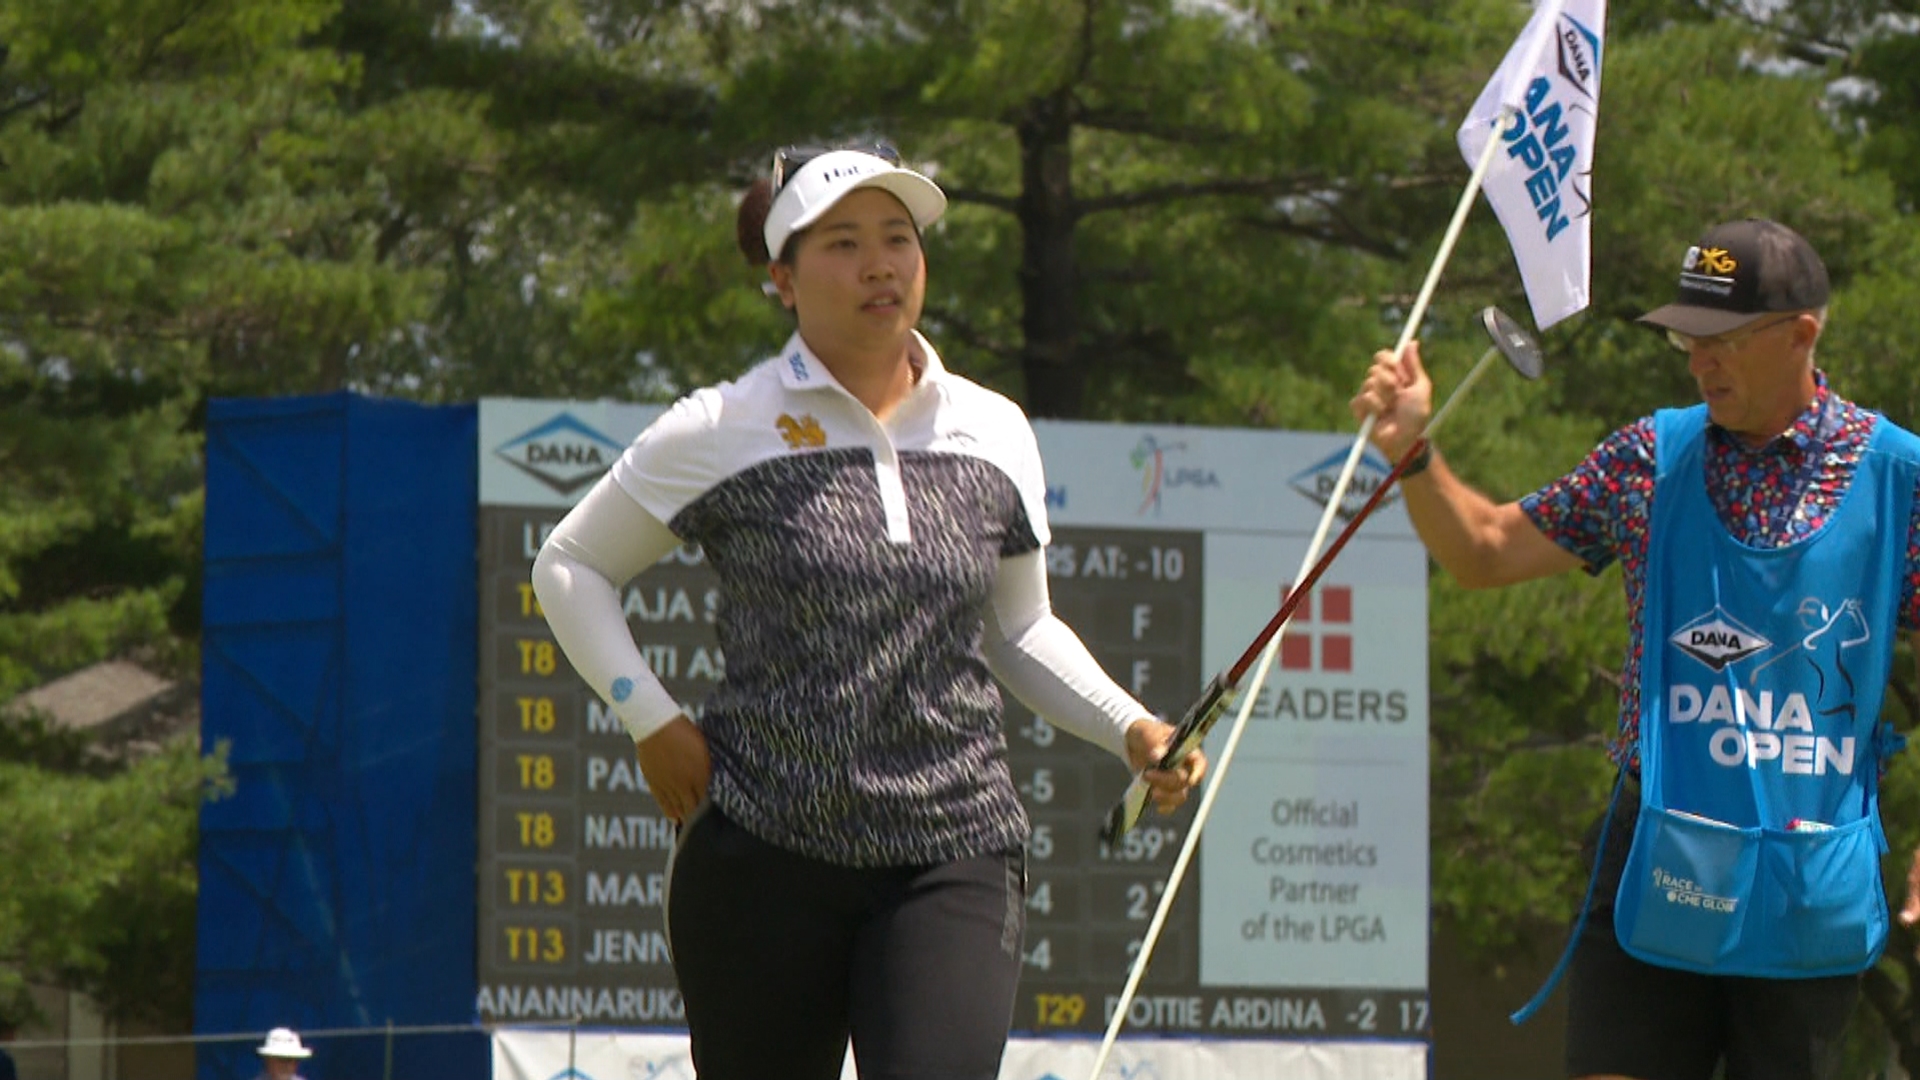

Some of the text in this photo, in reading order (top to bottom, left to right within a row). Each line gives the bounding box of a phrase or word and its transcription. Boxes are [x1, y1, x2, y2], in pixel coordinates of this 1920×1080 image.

[1525, 76, 1576, 184] ANA
[526, 443, 601, 465] DANA
[1136, 549, 1182, 581] -10
[623, 587, 695, 622] AJA
[1132, 606, 1151, 640] F
[1690, 629, 1742, 651] DANA
[517, 640, 556, 676] T8
[1132, 661, 1151, 694] F
[517, 698, 556, 733] T8
[1224, 686, 1410, 724] EADERS
[1668, 684, 1814, 732] DANA
[1708, 726, 1856, 776] OPEN
[517, 755, 555, 790] T8
[1019, 768, 1055, 803] -5
[516, 812, 555, 847] T8
[1271, 798, 1359, 829] Official
[1251, 836, 1378, 868] Cosmetics
[505, 869, 566, 905] T13
[1269, 875, 1360, 903] Partner
[505, 927, 565, 963] T13
[1240, 911, 1387, 944] of the LPGA
[1035, 994, 1086, 1026] T29
[1208, 996, 1327, 1029] ARDINA
[1346, 1000, 1378, 1031] -2
[1399, 1000, 1430, 1032] 17
